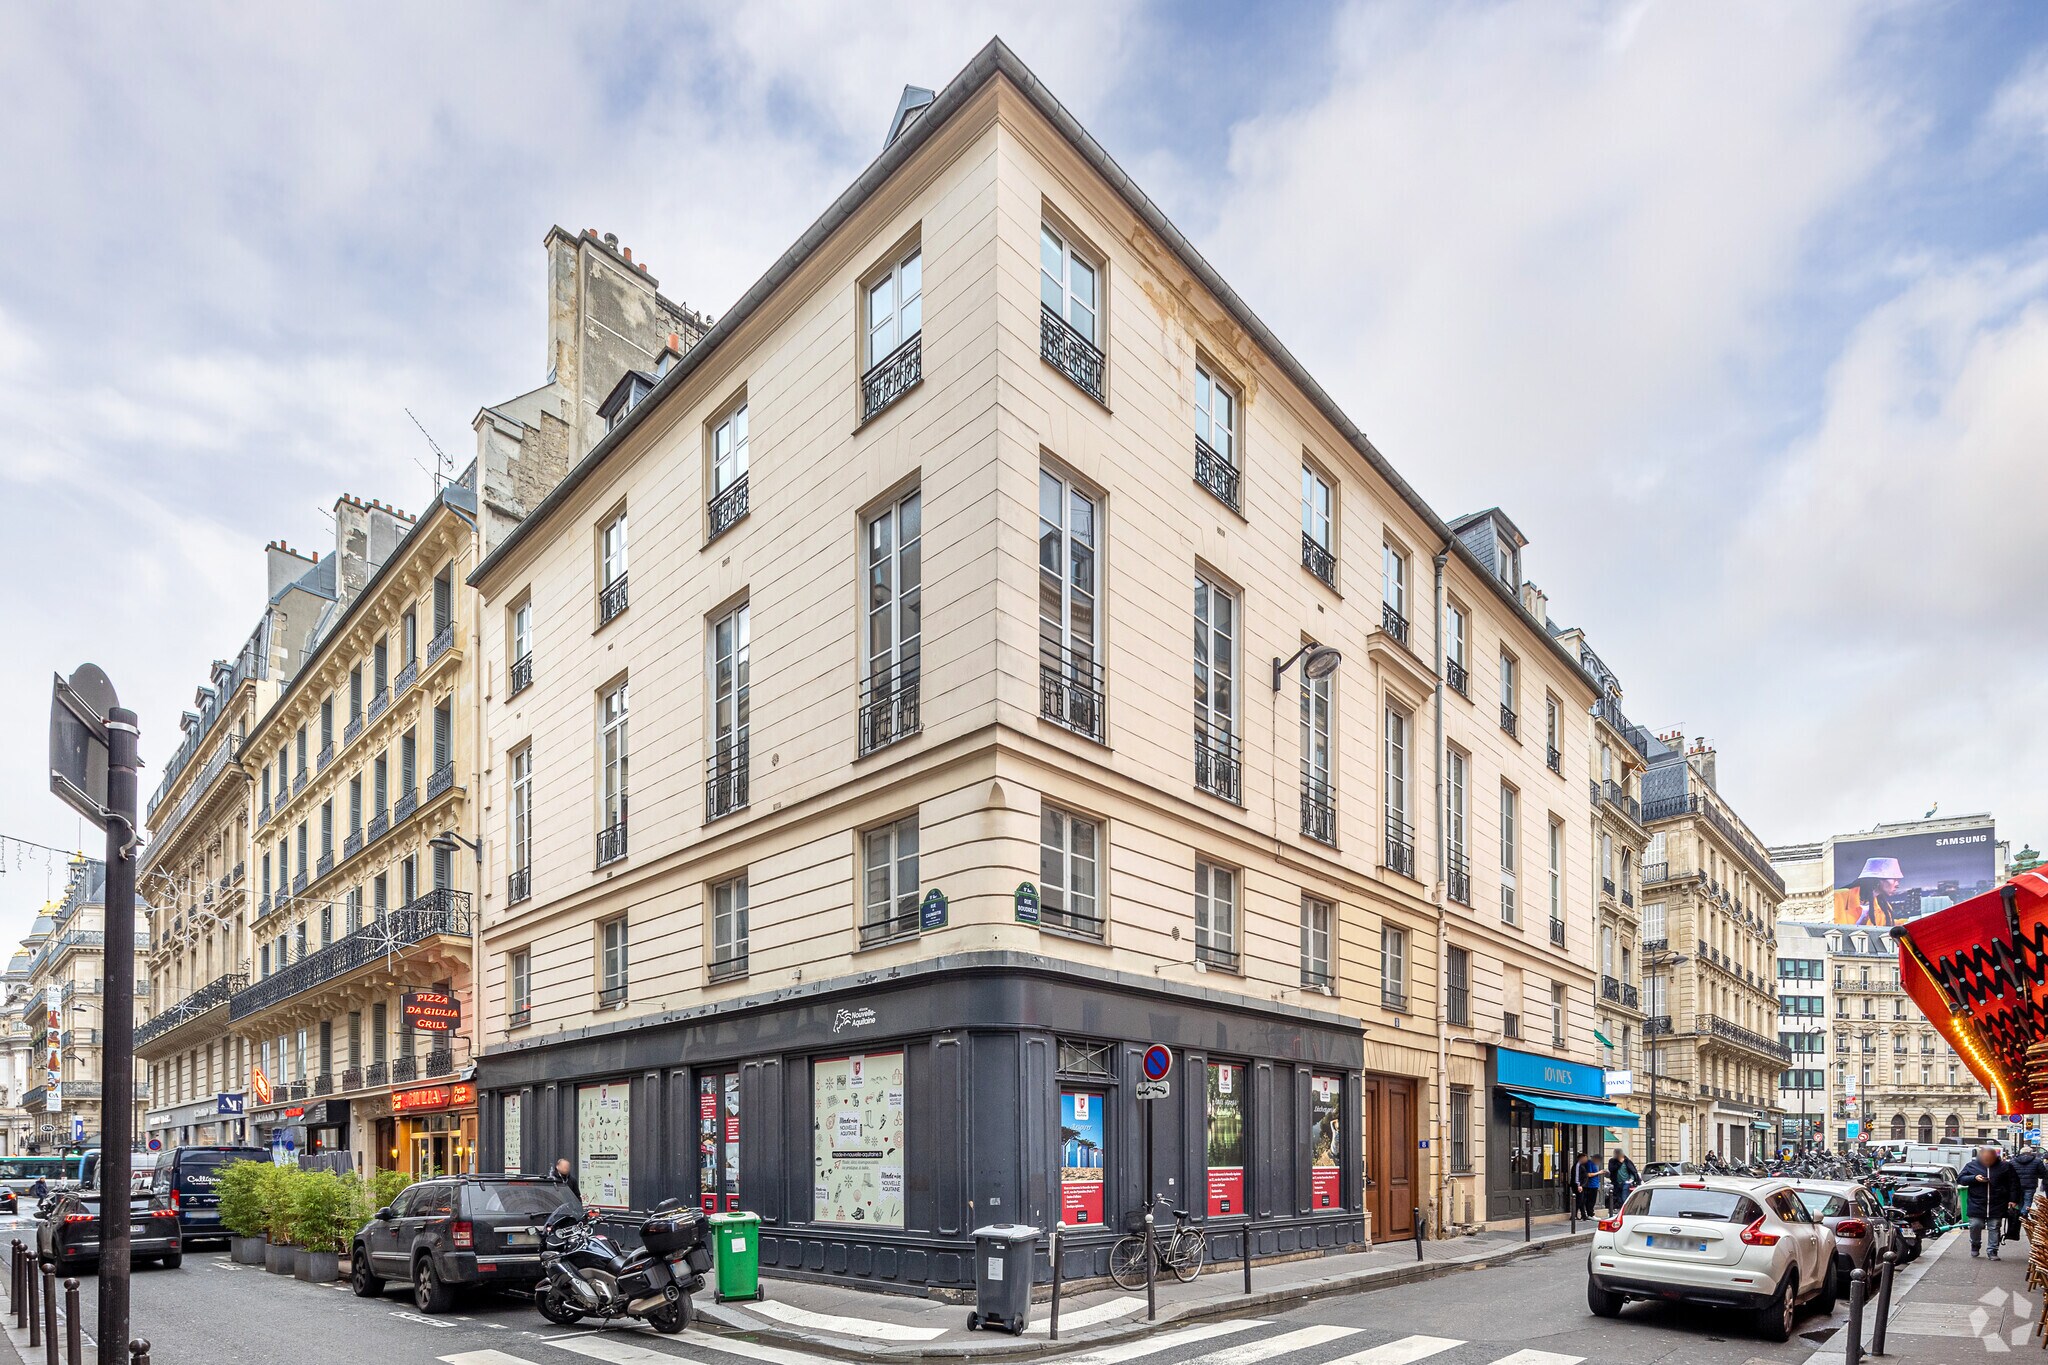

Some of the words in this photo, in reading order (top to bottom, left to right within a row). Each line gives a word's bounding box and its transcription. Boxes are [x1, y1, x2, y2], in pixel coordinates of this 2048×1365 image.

[1935, 834, 1987, 847] SAMSUNG
[1017, 905, 1038, 915] BOUDREAU
[416, 994, 448, 1004] PIZZA
[406, 1006, 421, 1014] DA
[423, 1007, 458, 1017] GIULIA
[851, 1009, 877, 1019] Nouvelle-
[417, 1019, 448, 1029] GRILL
[851, 1017, 876, 1028] Aquitaine
[77, 1125, 82, 1136] P
[1421, 1140, 1427, 1149] 8
[186, 1175, 222, 1185] Culligan
